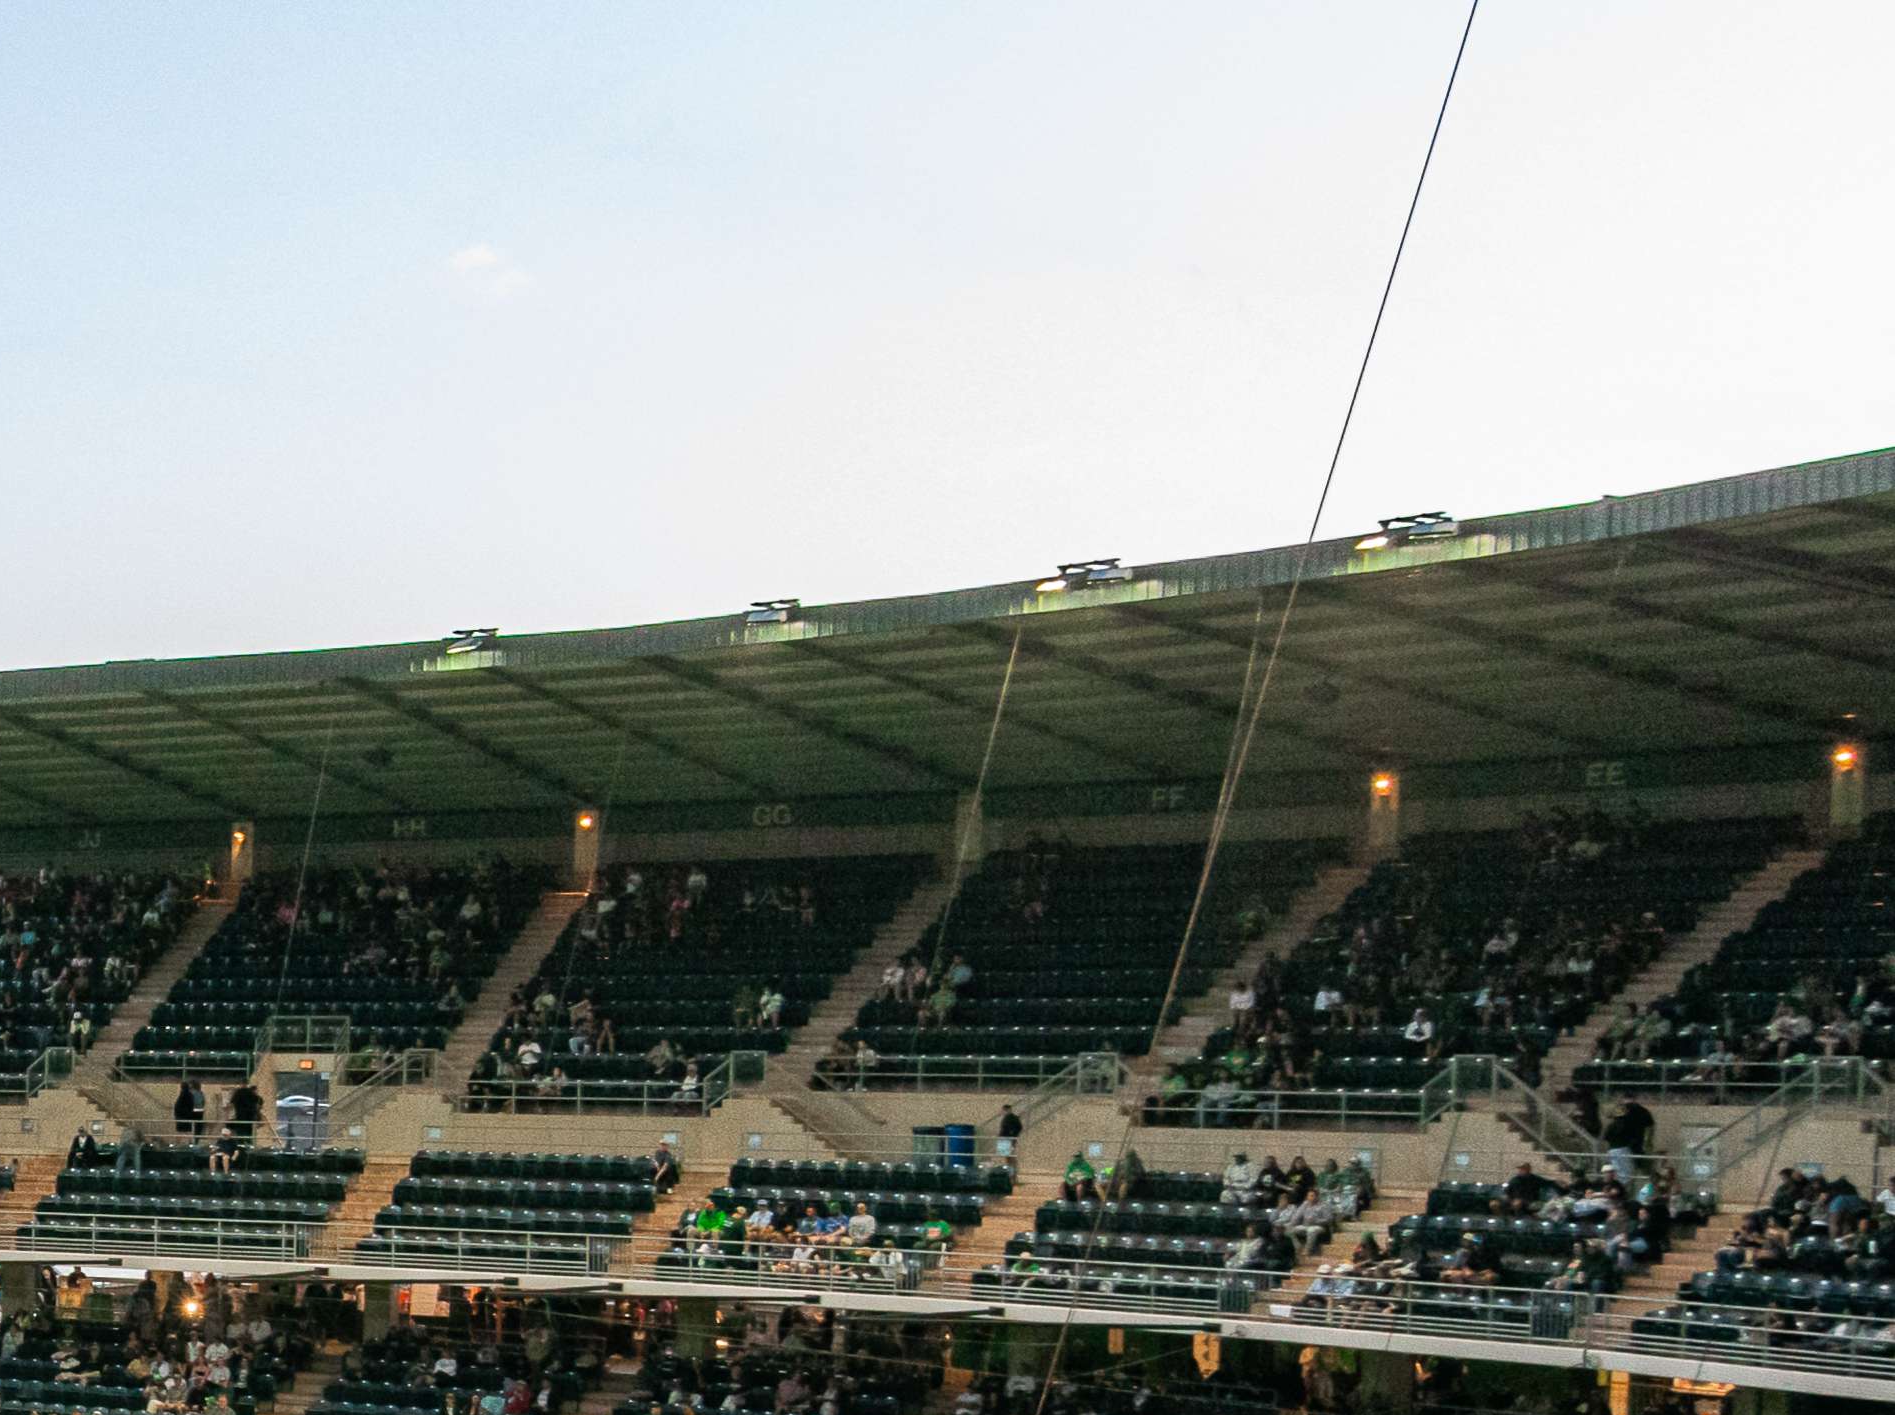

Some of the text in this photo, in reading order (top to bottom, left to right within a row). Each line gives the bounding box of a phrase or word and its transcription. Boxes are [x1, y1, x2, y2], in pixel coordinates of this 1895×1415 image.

[1586, 761, 1625, 785] EE
[752, 804, 792, 826] GG
[392, 819, 426, 838] HH
